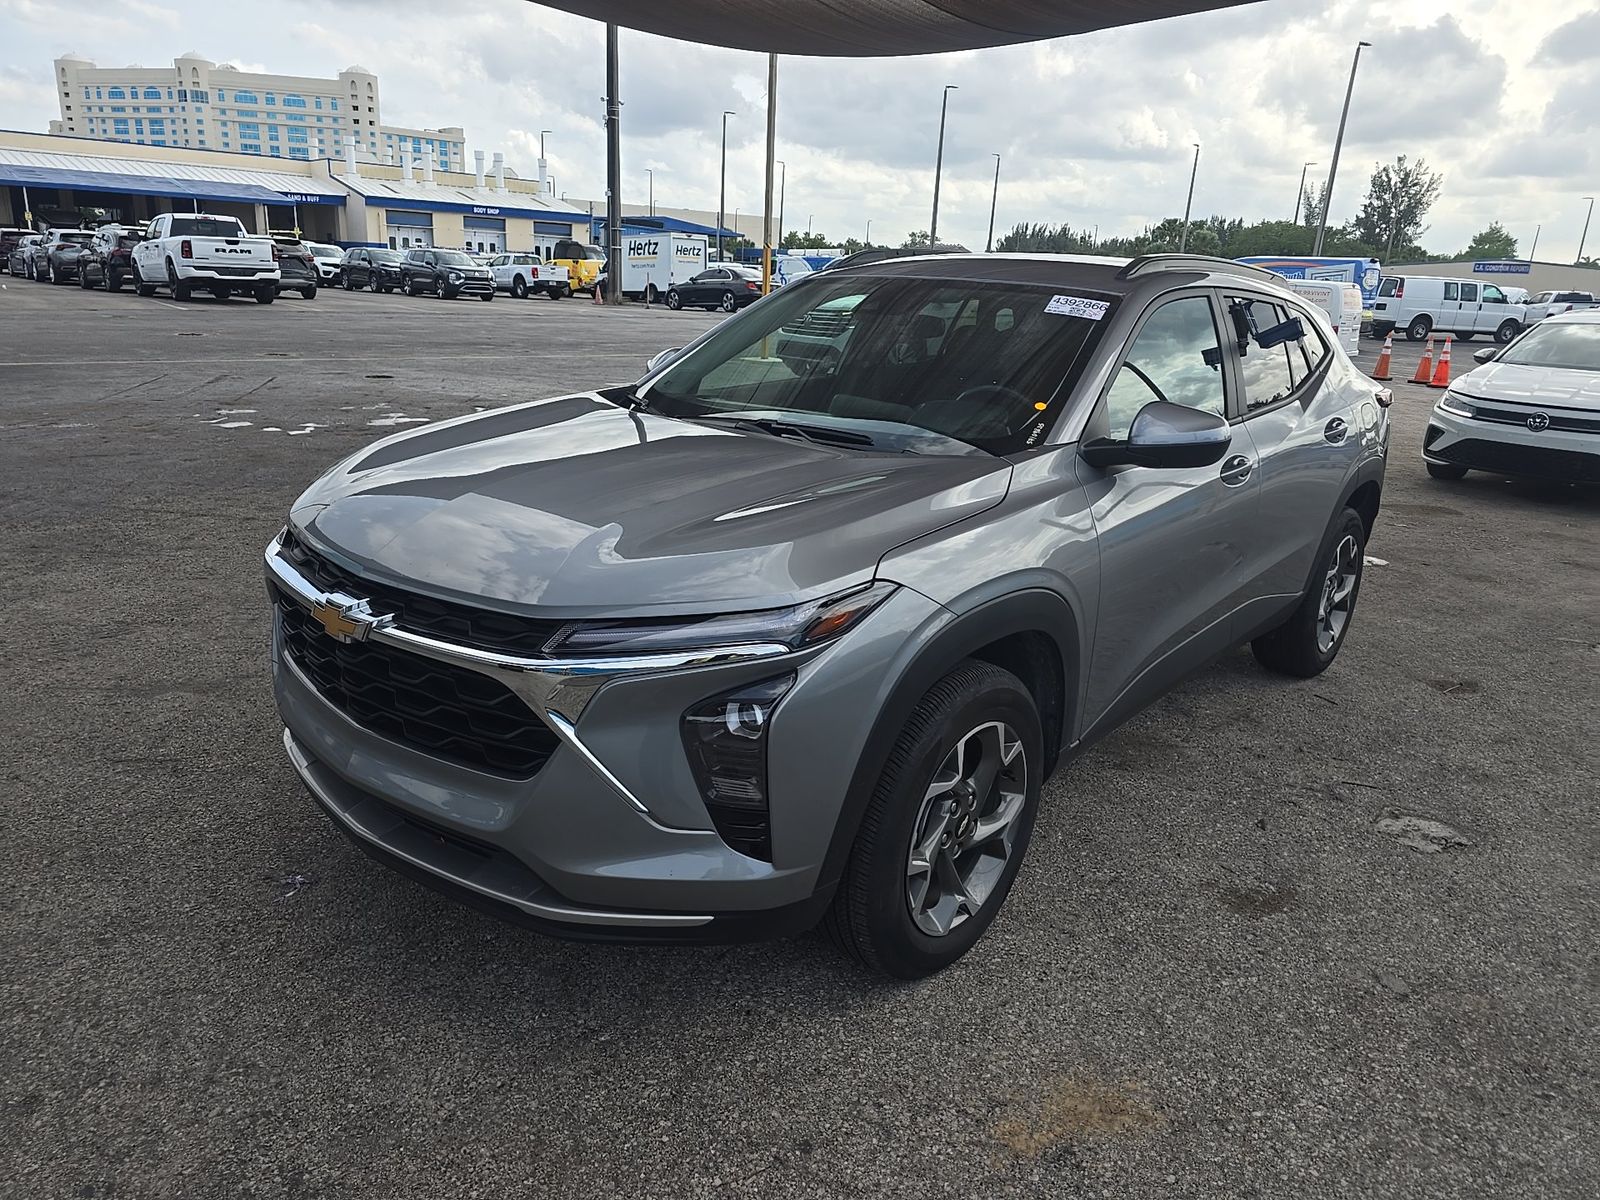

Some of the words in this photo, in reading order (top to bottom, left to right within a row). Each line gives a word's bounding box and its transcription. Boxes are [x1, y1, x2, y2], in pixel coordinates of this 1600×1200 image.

[473, 206, 486, 214] BODY
[628, 240, 659, 257] Hertz
[675, 245, 702, 257] Hertz
[1053, 297, 1109, 311] 4392866
